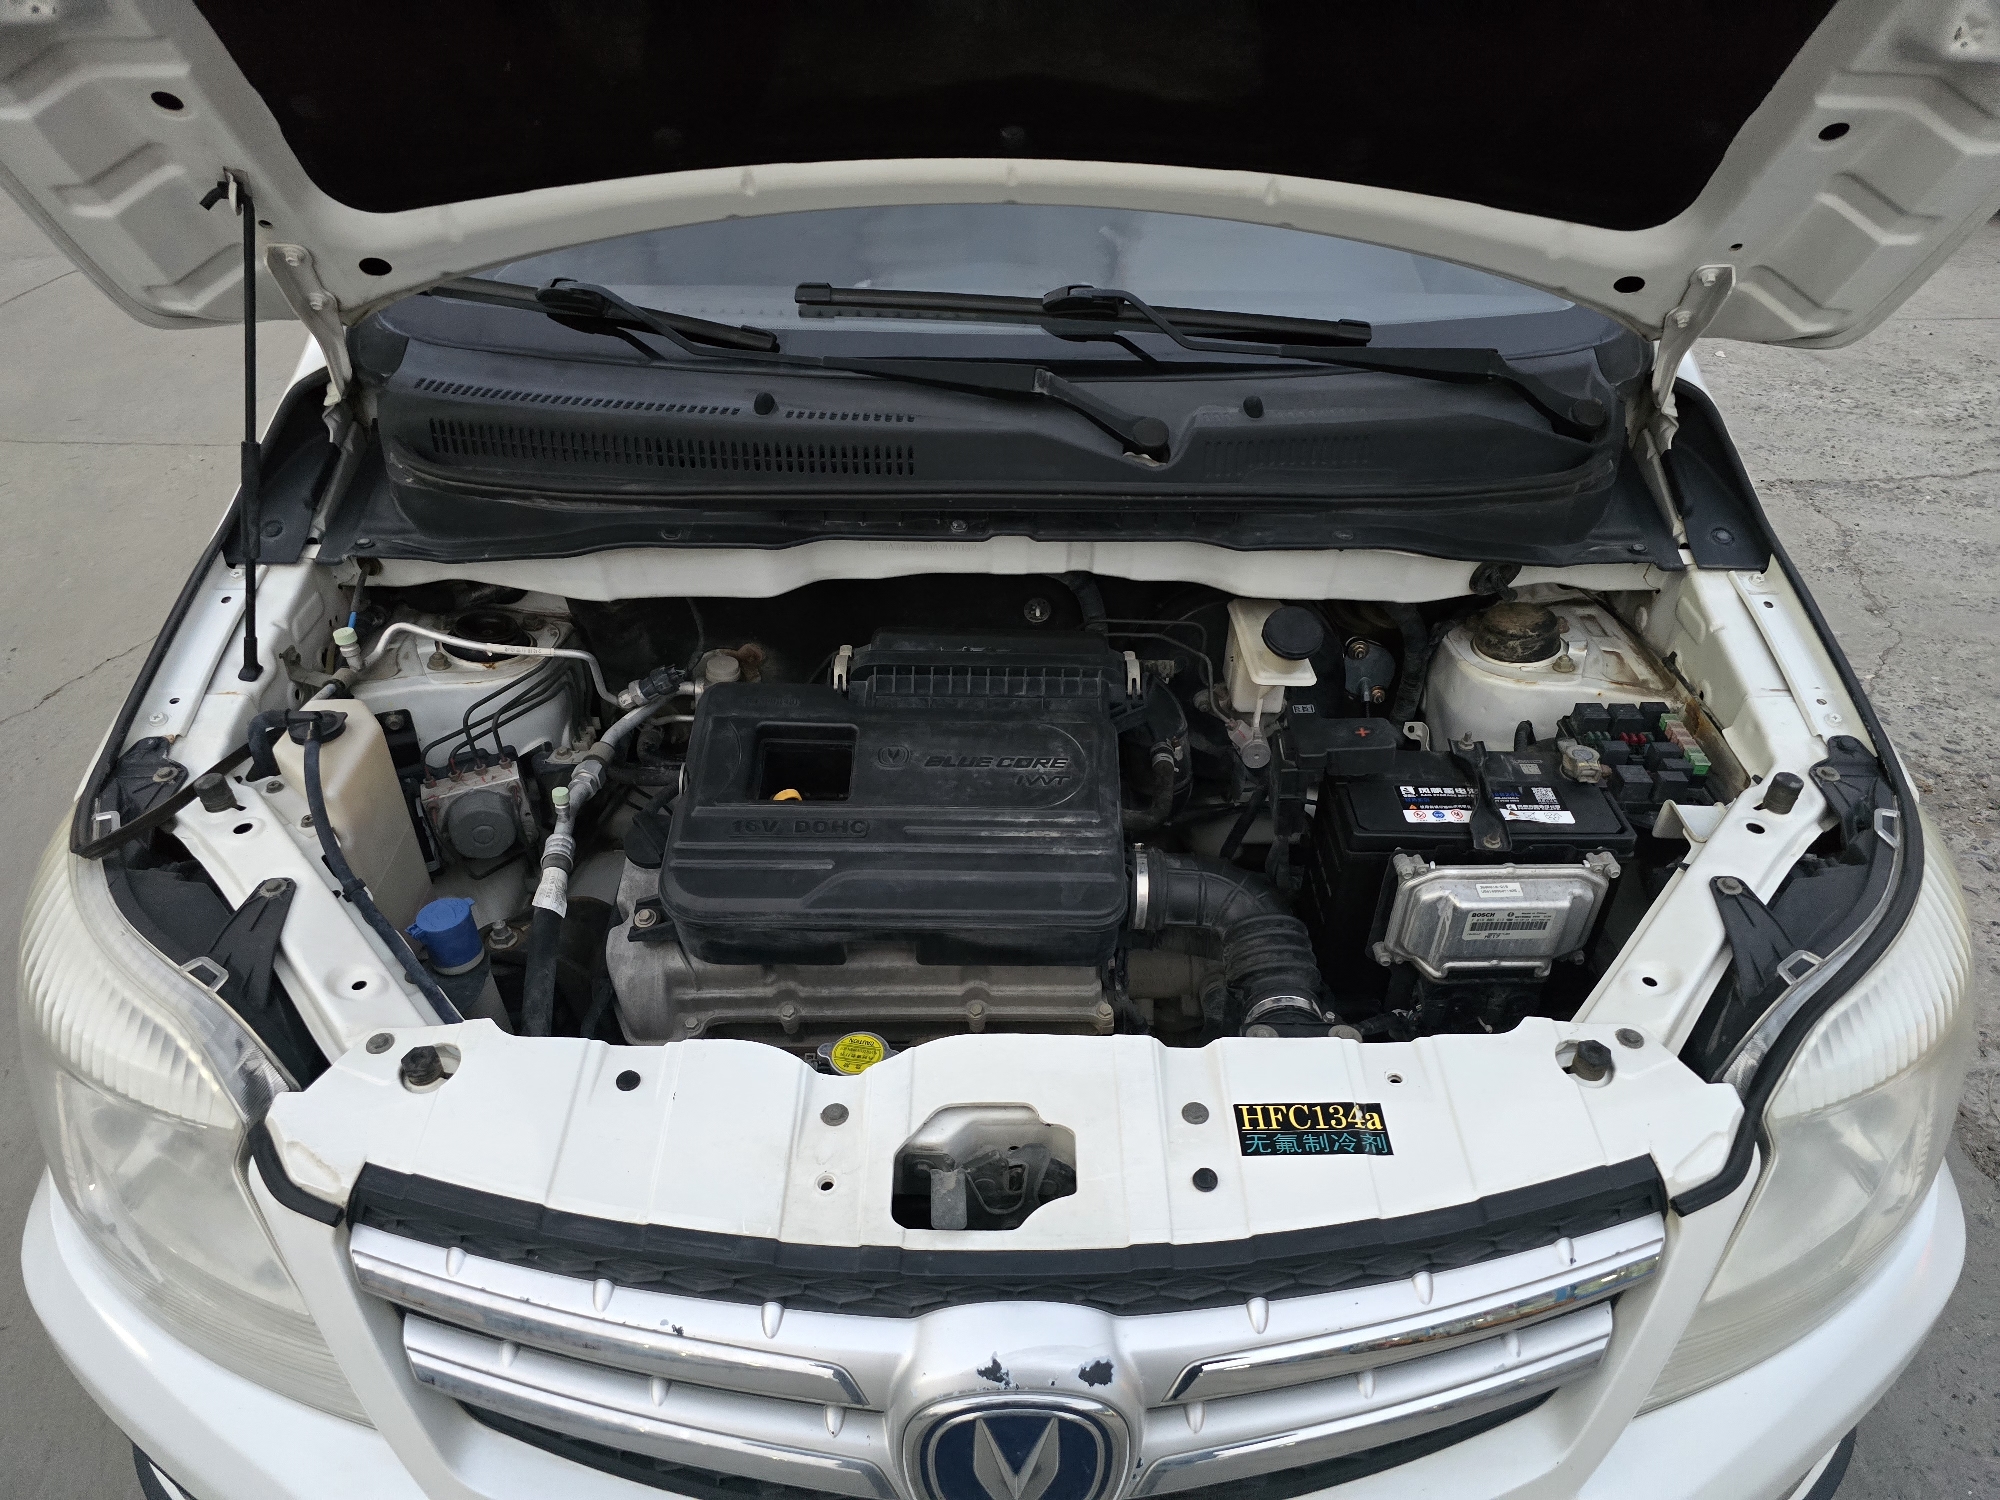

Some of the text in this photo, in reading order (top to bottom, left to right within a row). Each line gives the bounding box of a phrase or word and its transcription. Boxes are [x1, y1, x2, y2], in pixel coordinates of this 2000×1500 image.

[924, 756, 1069, 769] BLUE CORE
[731, 819, 868, 834] 16V DOHC
[849, 1038, 875, 1047] CAUTION
[1238, 1104, 1383, 1130] HFC134a
[1245, 1132, 1388, 1153] 无氟制冷剂
